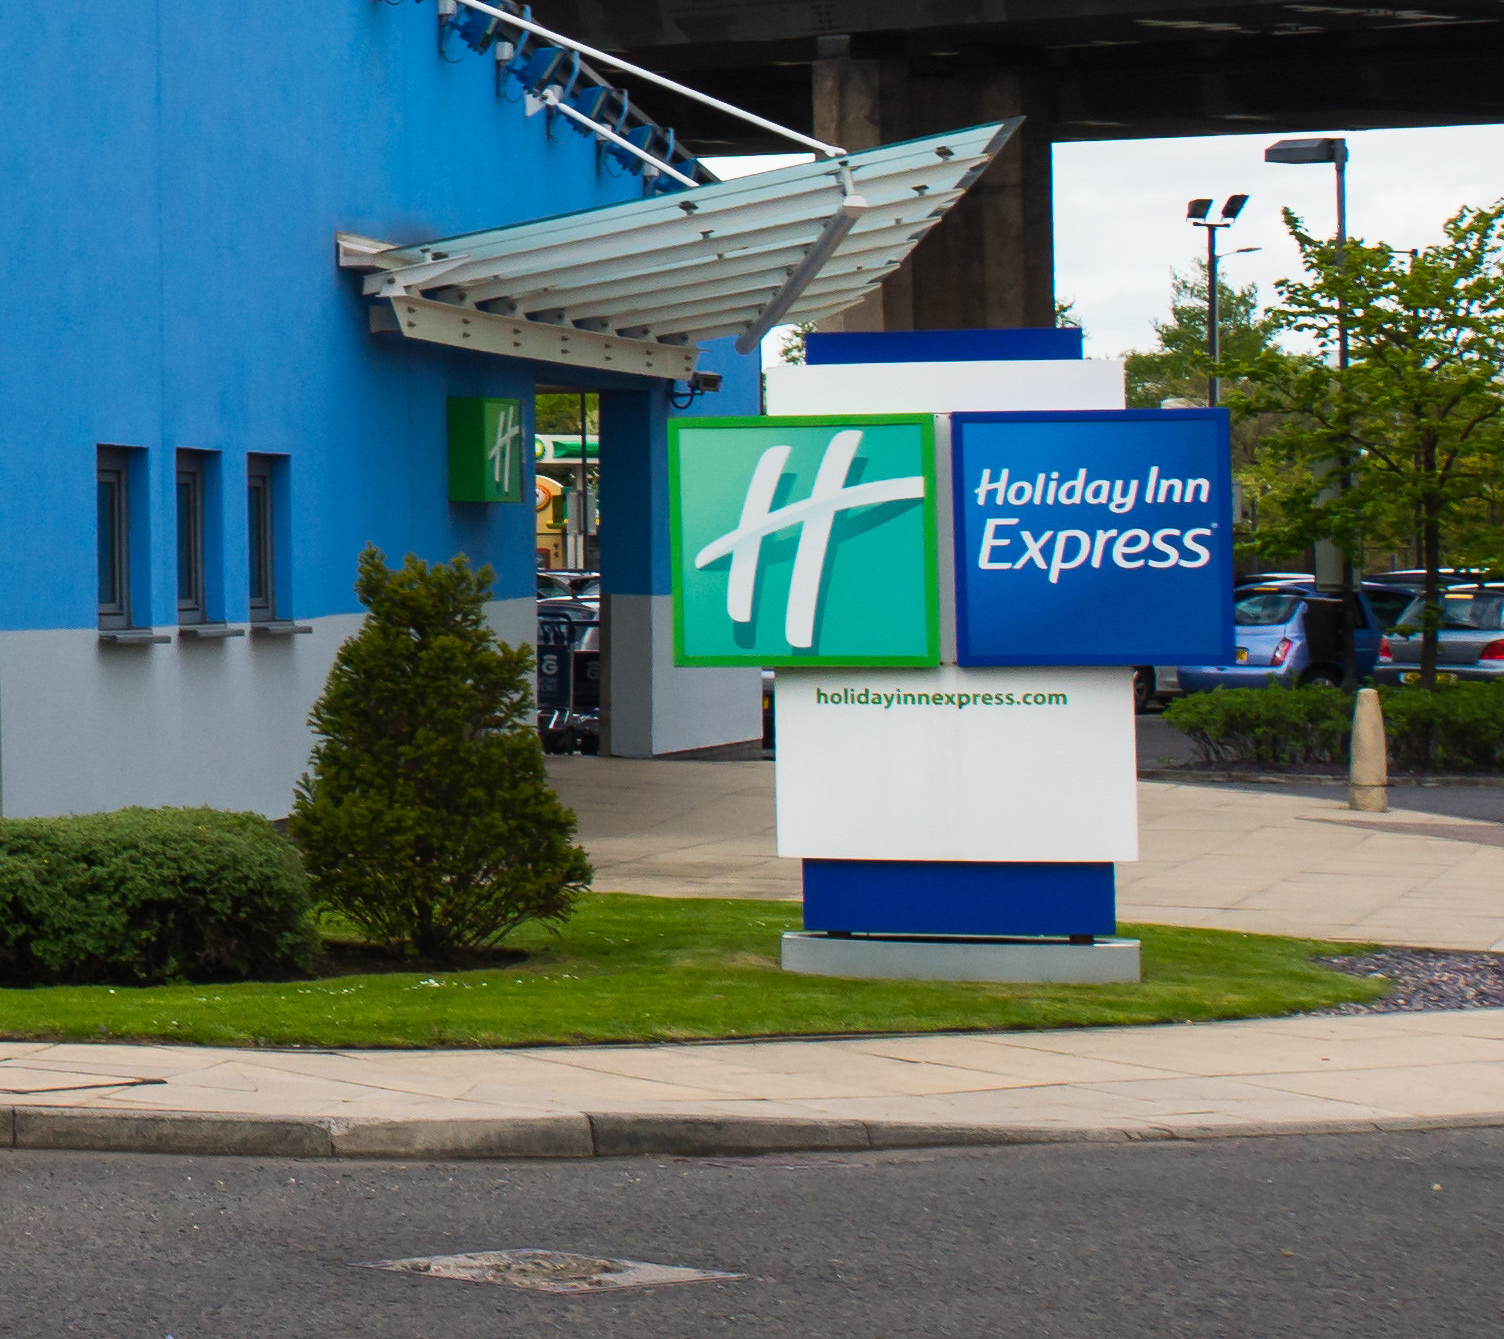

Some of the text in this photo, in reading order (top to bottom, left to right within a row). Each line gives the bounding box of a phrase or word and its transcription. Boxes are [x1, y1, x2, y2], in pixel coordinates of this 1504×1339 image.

[974, 465, 1210, 514] Holiday Inn
[978, 517, 1213, 584] Express
[815, 687, 1068, 709] holidayinnexpress.com
